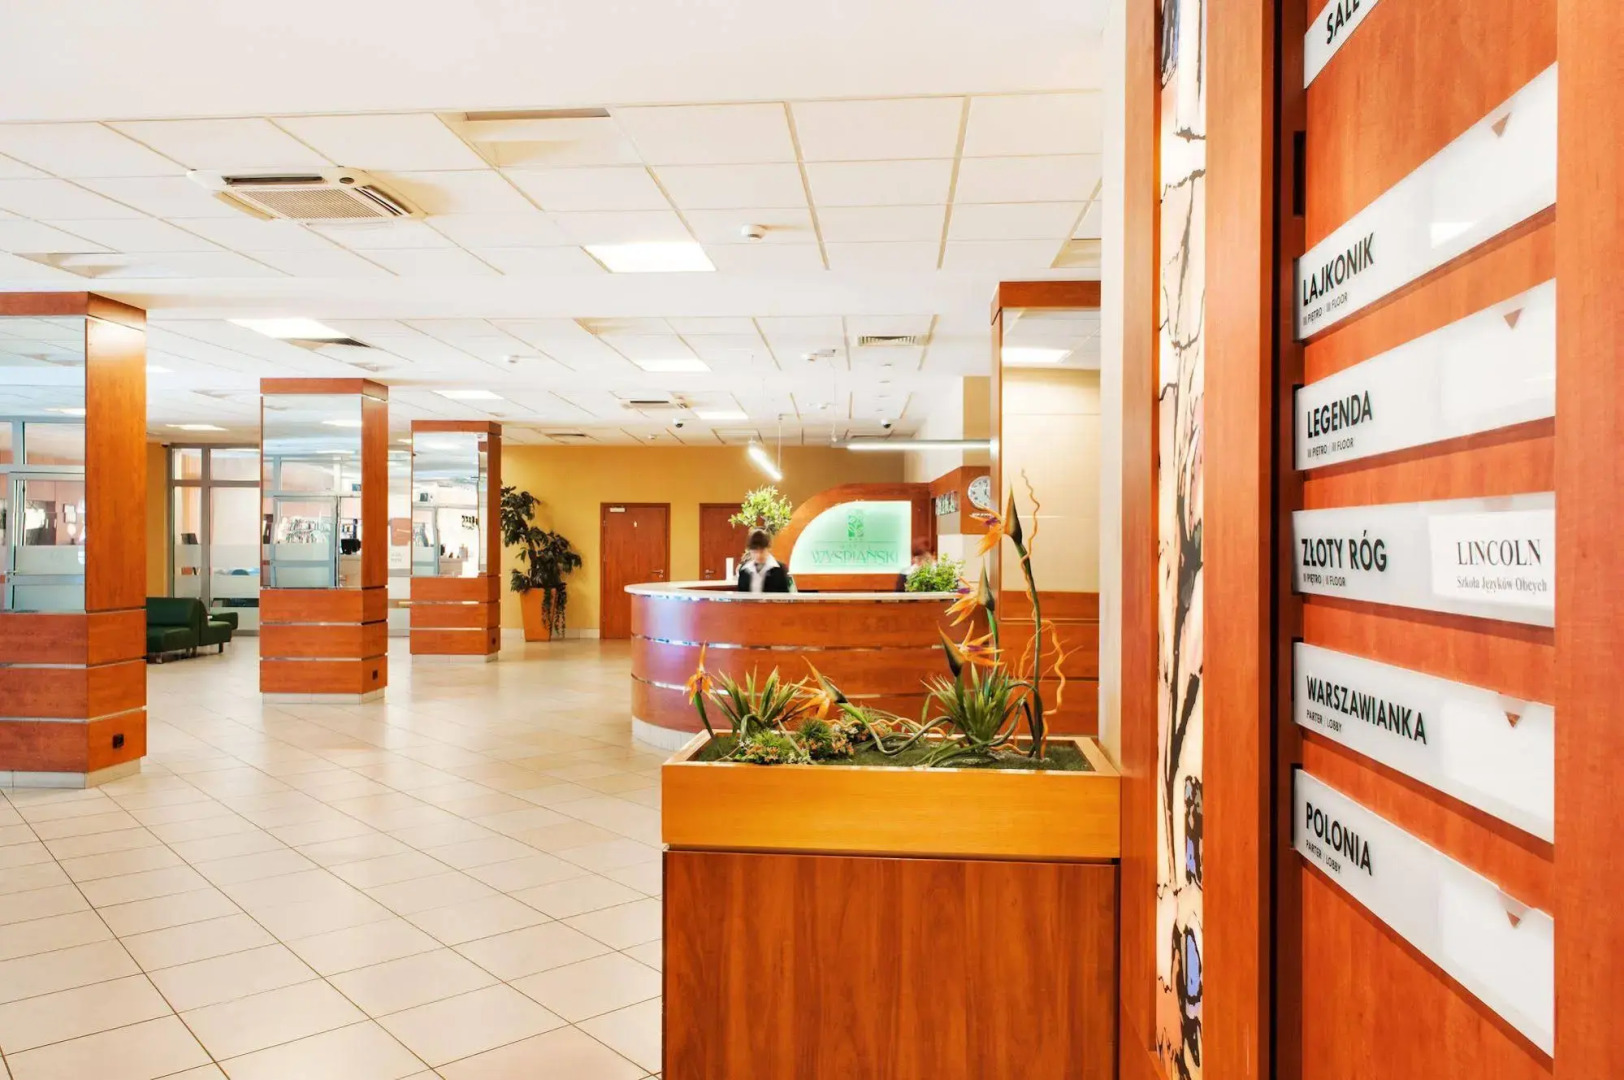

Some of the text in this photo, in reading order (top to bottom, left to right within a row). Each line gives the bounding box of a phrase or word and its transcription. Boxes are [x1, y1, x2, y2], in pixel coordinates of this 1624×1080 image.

[1302, 232, 1374, 307] LAJKONIK
[1331, 292, 1348, 309] FLOOR
[1307, 389, 1373, 439] LEGENDA
[1337, 437, 1354, 451] FLOOR
[1301, 529, 1388, 572] ZŁOTY RÓG
[1456, 538, 1542, 567] LINCOLN
[1329, 575, 1346, 587] FLOOR
[1456, 576, 1548, 595] Szkoła Języków Obcych
[1306, 675, 1428, 746] WARSZAWIANKA
[1306, 709, 1342, 733] PARTER LOBBY
[1306, 801, 1373, 876] POLONIA
[1305, 839, 1341, 874] PARTER LOBBY
